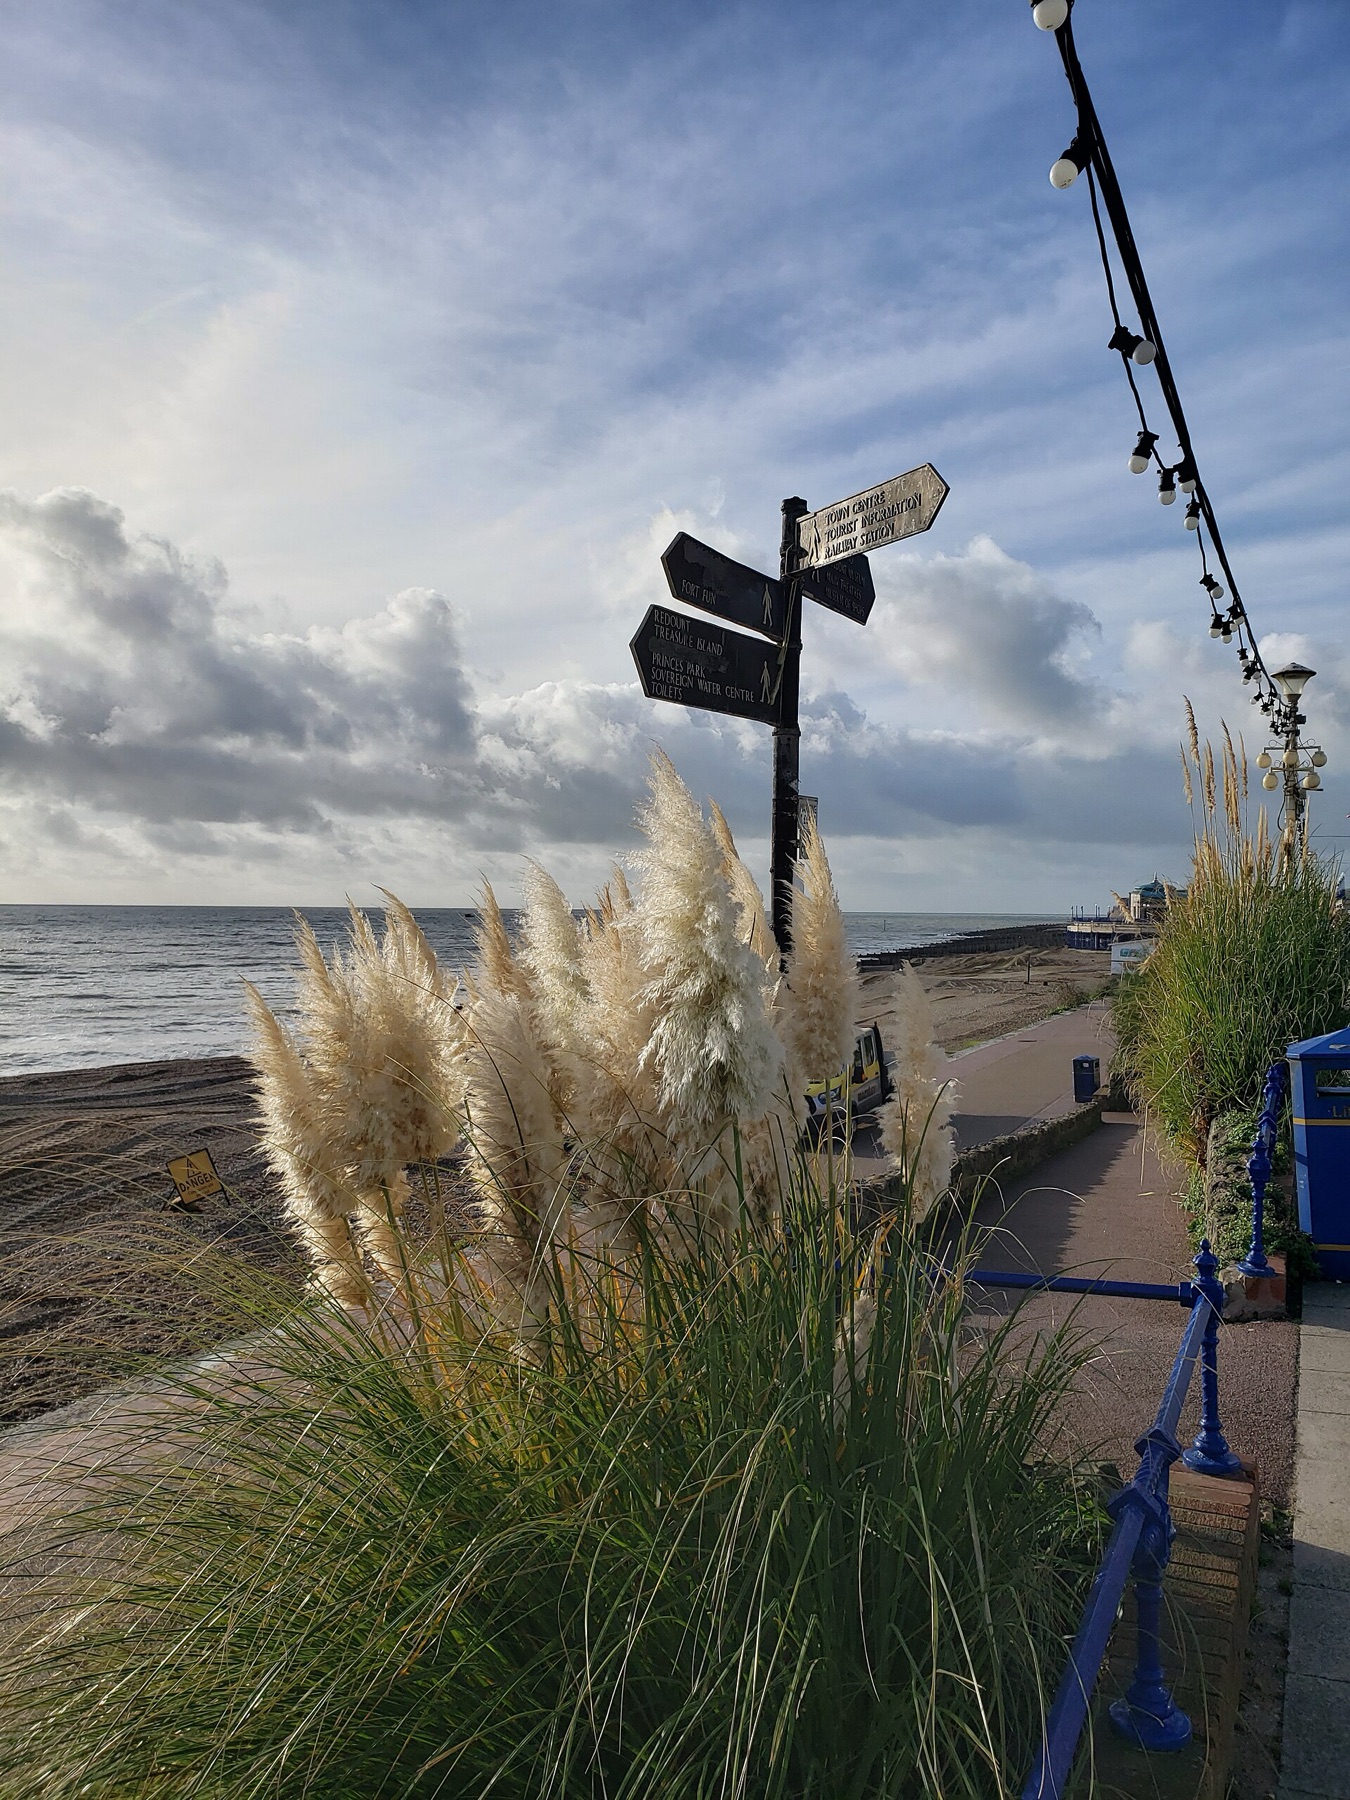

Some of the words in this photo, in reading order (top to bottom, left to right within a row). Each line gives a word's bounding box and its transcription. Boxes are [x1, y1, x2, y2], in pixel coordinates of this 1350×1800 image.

[825, 505, 850, 526] TOWN
[852, 491, 886, 514] CENTRE
[825, 518, 859, 543] TOURIST
[861, 492, 922, 528] INFORMATION
[825, 536, 858, 559] RAILWAY
[860, 523, 895, 547] STATION
[681, 579, 700, 598] FORT
[702, 589, 717, 605] FUN
[654, 609, 691, 632] REDOUBT
[654, 624, 694, 648] TREASURE
[696, 637, 723, 656] ISLAND
[652, 652, 684, 673] PRINCES
[686, 662, 706, 679] PARK
[651, 666, 694, 689] SOVEREIGN
[697, 679, 722, 696] WATER
[725, 685, 755, 703] CENTRE
[651, 681, 683, 700] TOILETS
[178, 1171, 216, 1192] DANGER
